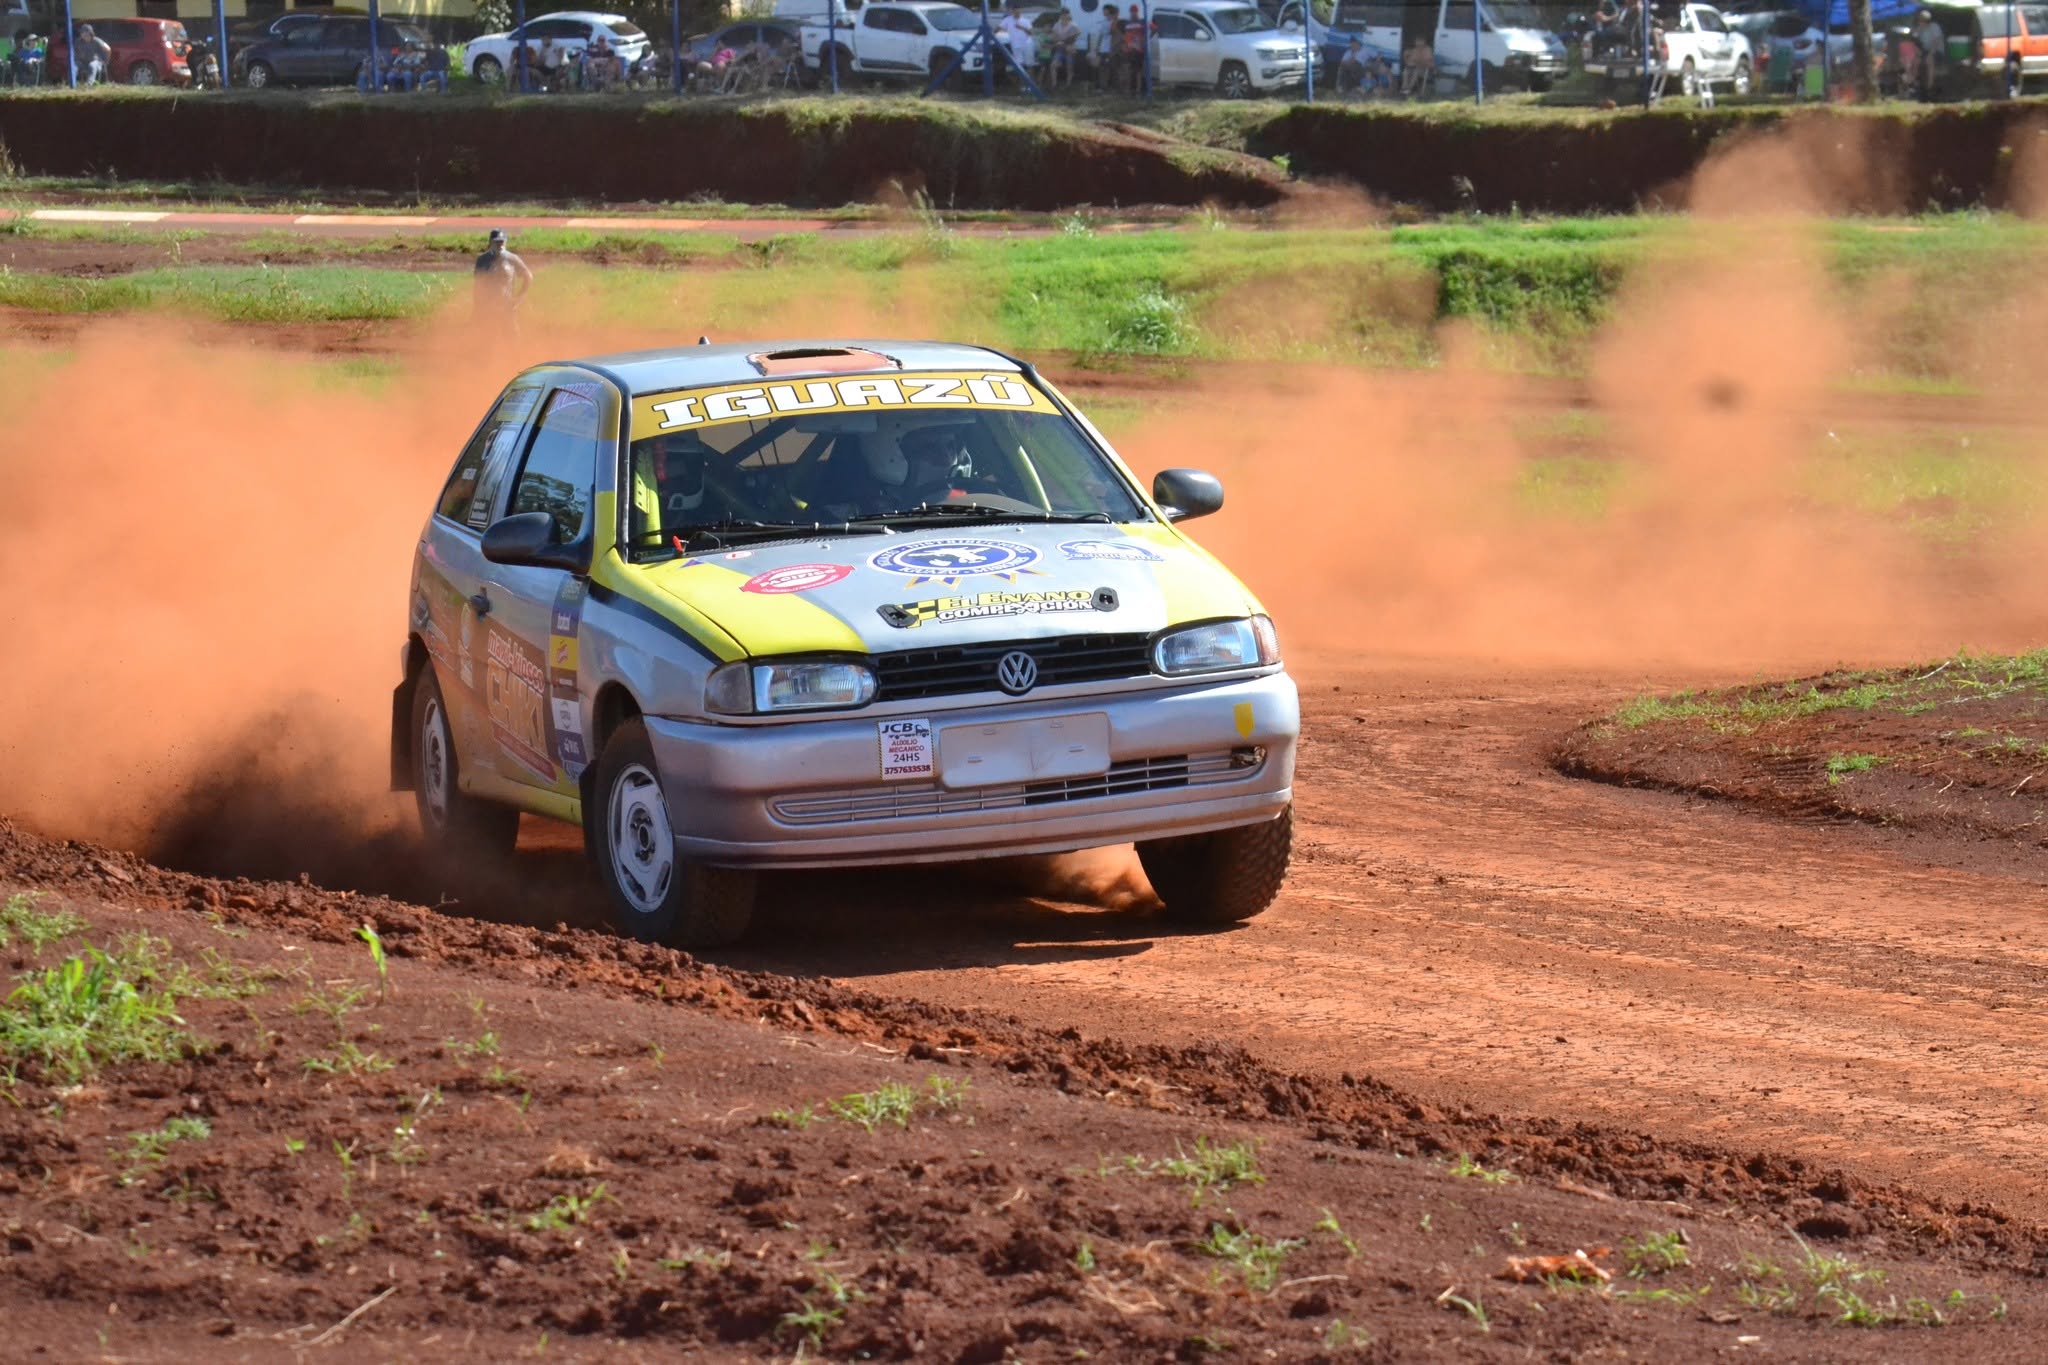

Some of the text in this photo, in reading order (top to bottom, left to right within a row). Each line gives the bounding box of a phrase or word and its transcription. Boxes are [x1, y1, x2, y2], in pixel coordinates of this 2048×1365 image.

[652, 374, 1034, 429] IGUAZÚ
[978, 590, 1092, 607] ENANO
[882, 722, 913, 734] JCB
[893, 752, 920, 763] 24HS
